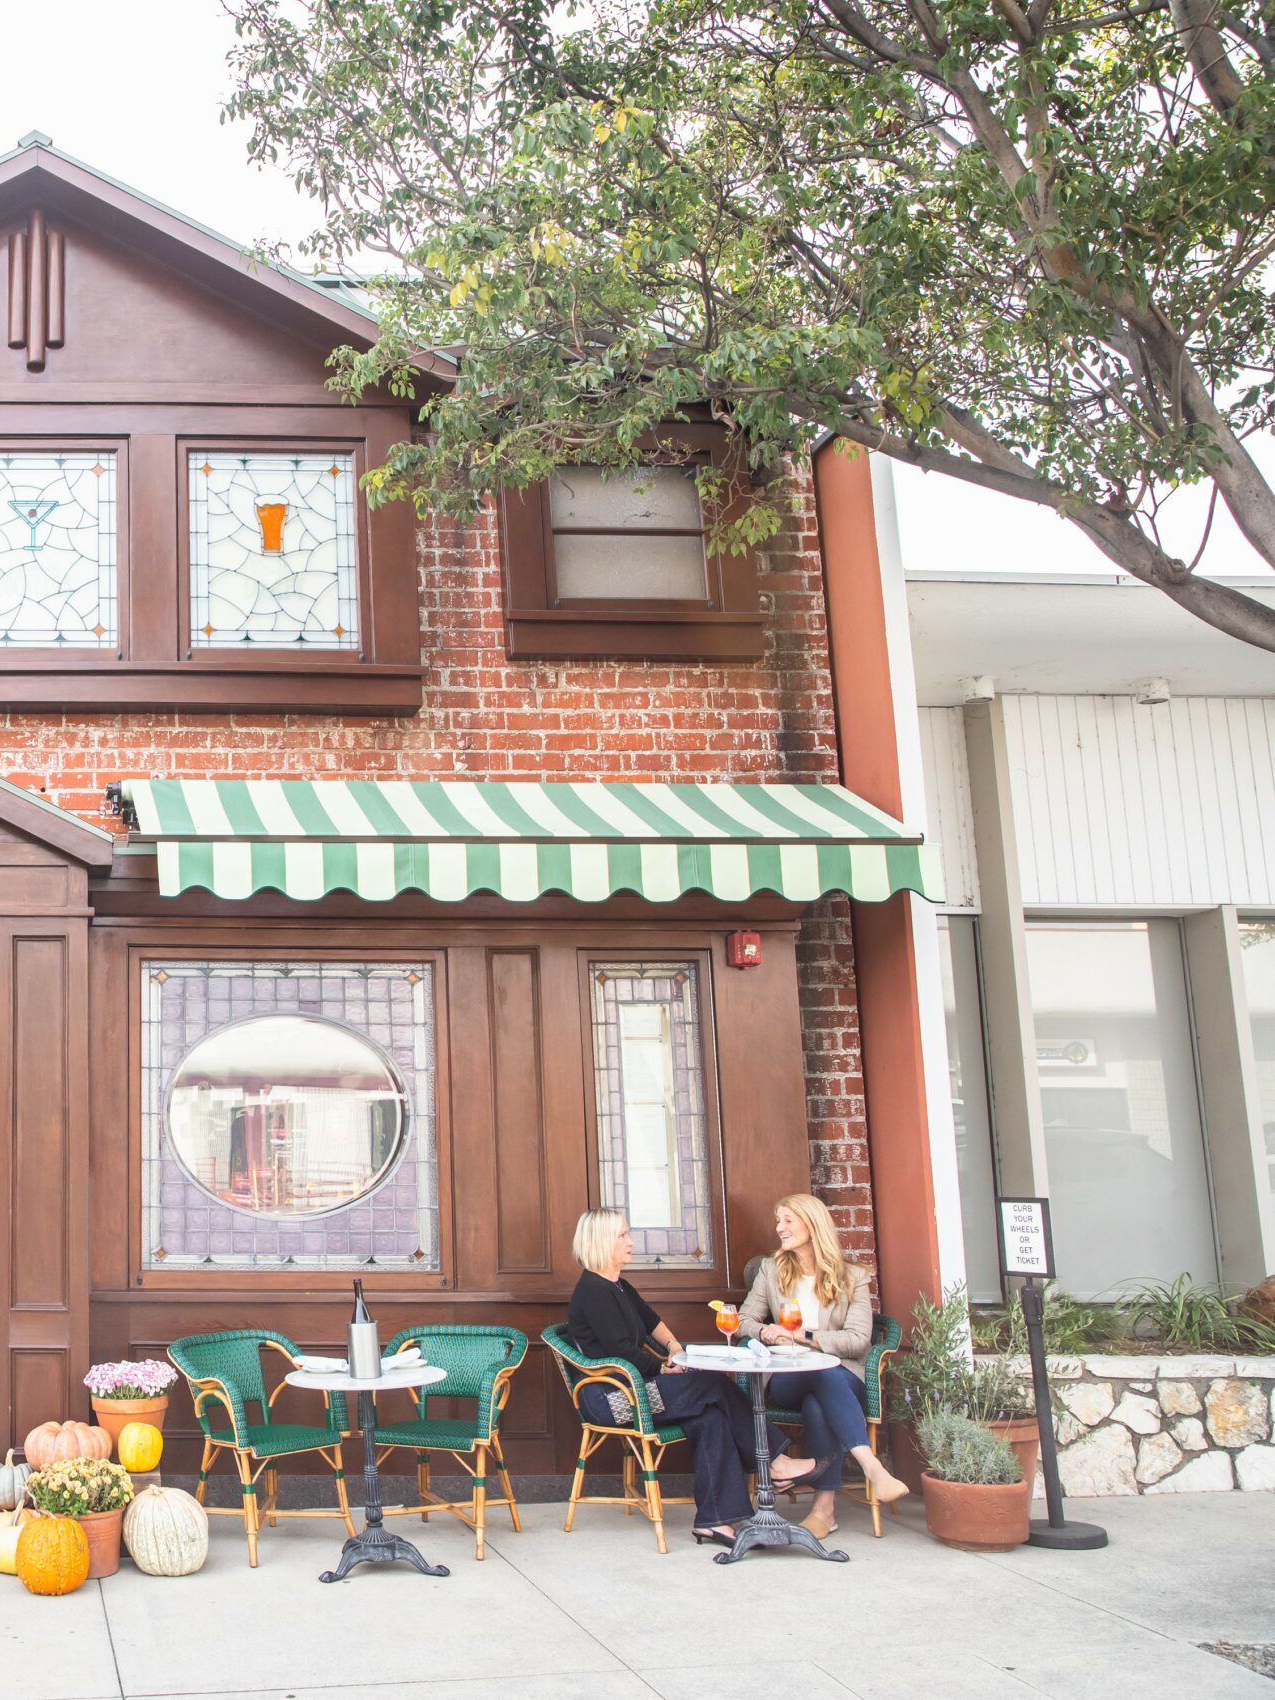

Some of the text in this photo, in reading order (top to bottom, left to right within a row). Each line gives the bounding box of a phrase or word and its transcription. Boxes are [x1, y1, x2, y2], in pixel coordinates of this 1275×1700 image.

[1012, 1204, 1033, 1213] CURB
[1014, 1215, 1033, 1223] YOUR
[1010, 1225, 1040, 1234] WHEELS
[1019, 1246, 1033, 1254] GET
[1016, 1256, 1040, 1265] TICKET
